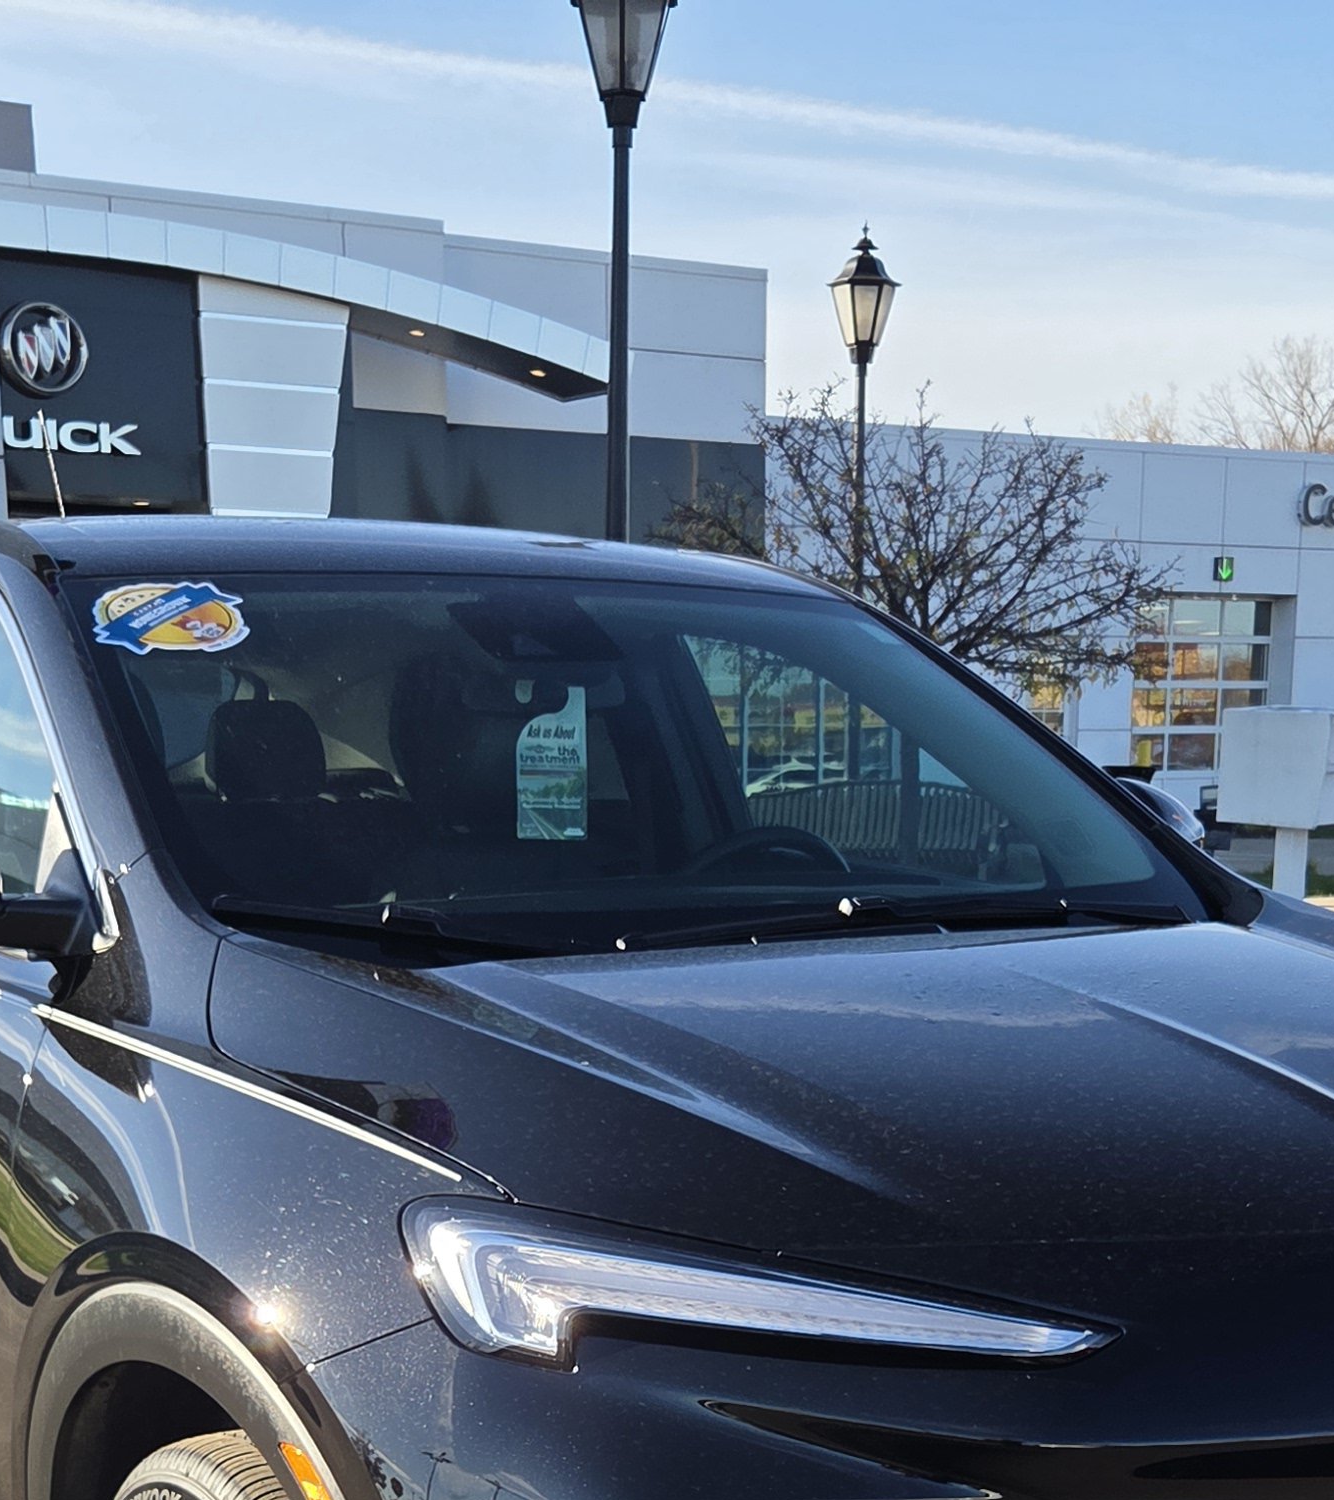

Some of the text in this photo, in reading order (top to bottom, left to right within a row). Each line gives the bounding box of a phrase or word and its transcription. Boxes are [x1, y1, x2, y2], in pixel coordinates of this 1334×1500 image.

[2, 415, 142, 456] UICK
[527, 724, 541, 738] Ask
[553, 725, 576, 740] About
[557, 745, 578, 756] the
[519, 753, 581, 764] treatment
